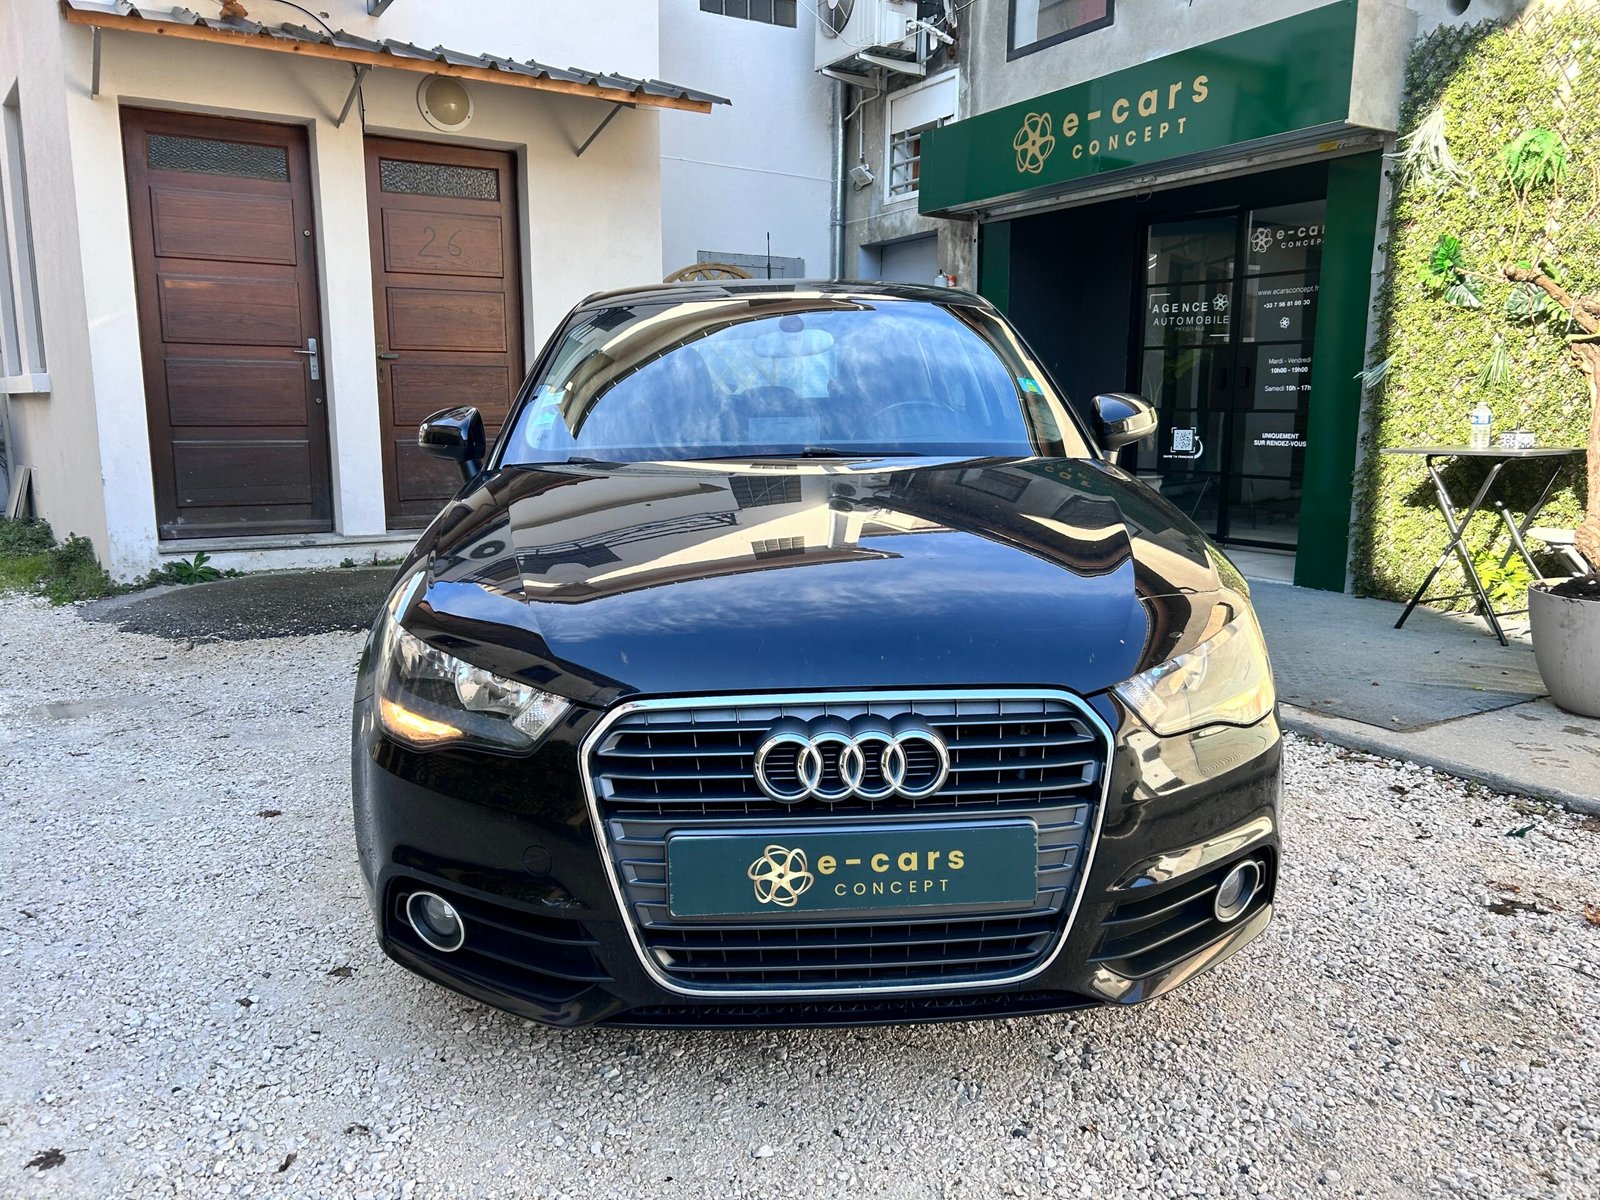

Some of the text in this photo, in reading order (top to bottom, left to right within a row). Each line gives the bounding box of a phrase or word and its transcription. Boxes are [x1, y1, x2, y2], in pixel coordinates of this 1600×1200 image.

[1062, 75, 1209, 138] e-cars
[1072, 117, 1187, 159] CONCEPT
[1276, 225, 1325, 240] e-ca
[418, 226, 463, 259] 26
[1281, 238, 1324, 249] CONCEP
[1151, 302, 1209, 314] AGENCE
[1152, 315, 1230, 326] AUTOMOBILE
[1287, 356, 1312, 364] Vendredi
[1261, 432, 1299, 440] UNIQUEMENT
[816, 848, 966, 875] e-cars
[834, 878, 950, 897] CONCEPT
